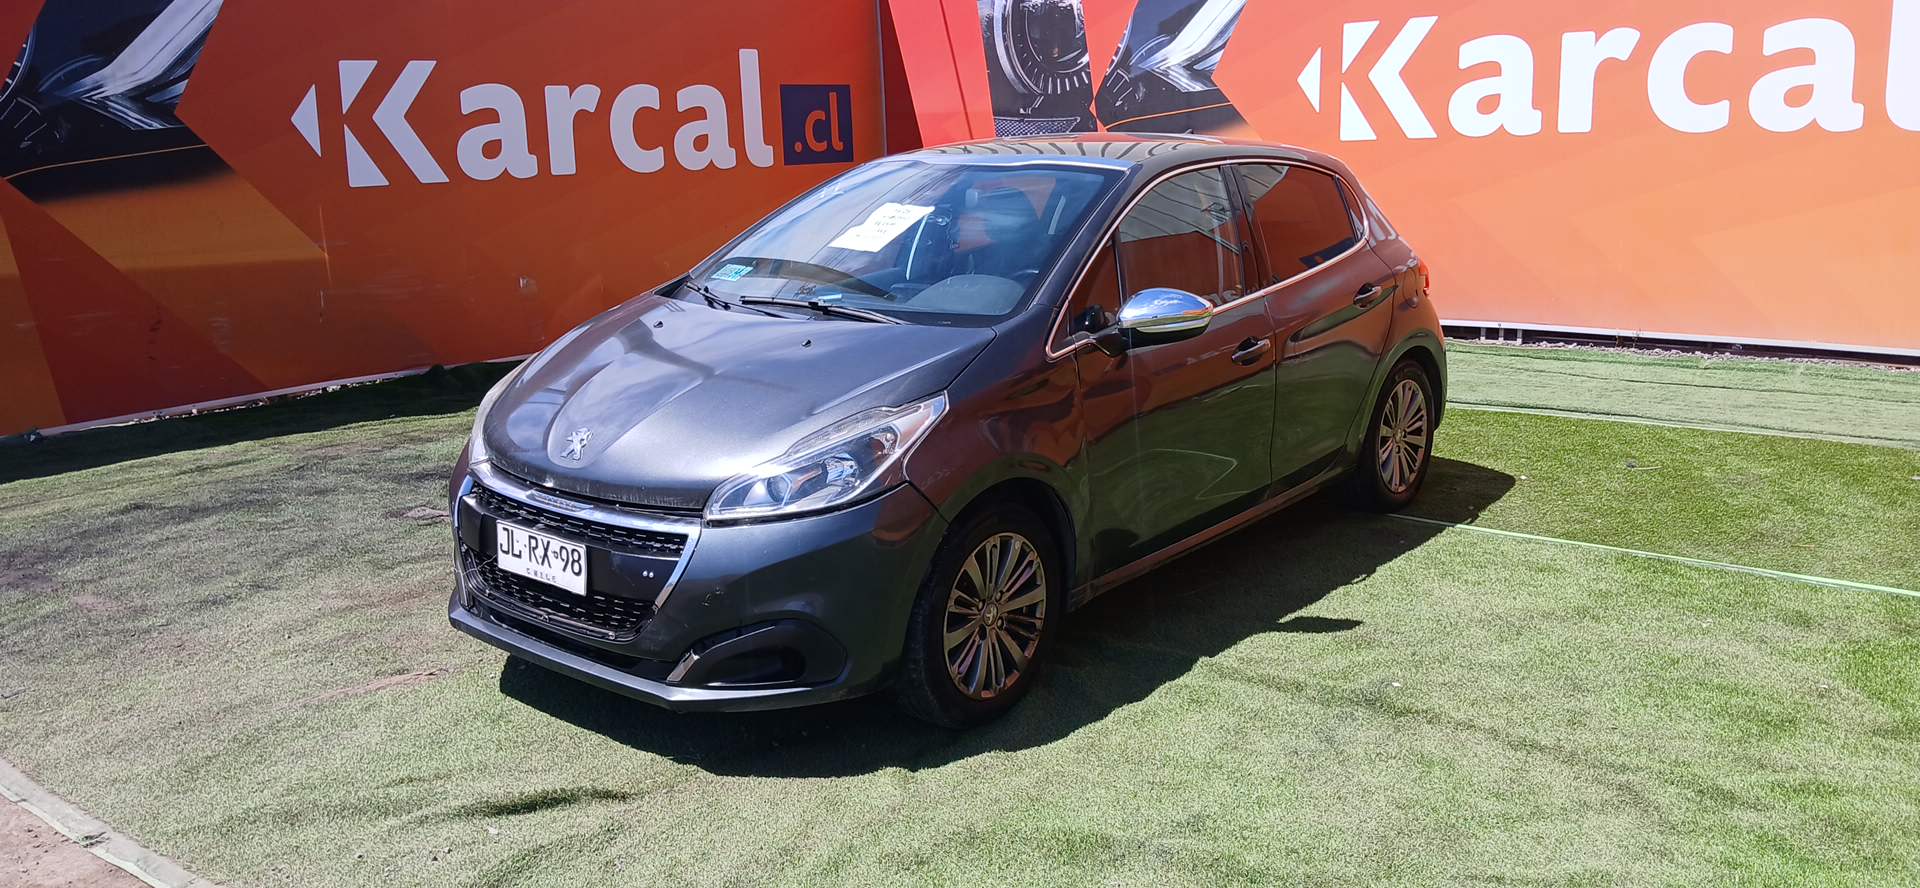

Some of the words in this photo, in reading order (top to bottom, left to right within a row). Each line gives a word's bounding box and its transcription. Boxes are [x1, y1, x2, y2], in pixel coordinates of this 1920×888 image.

[338, 48, 774, 188] Karcal
[794, 92, 844, 152] .cl
[1340, 0, 1920, 142] Karcal
